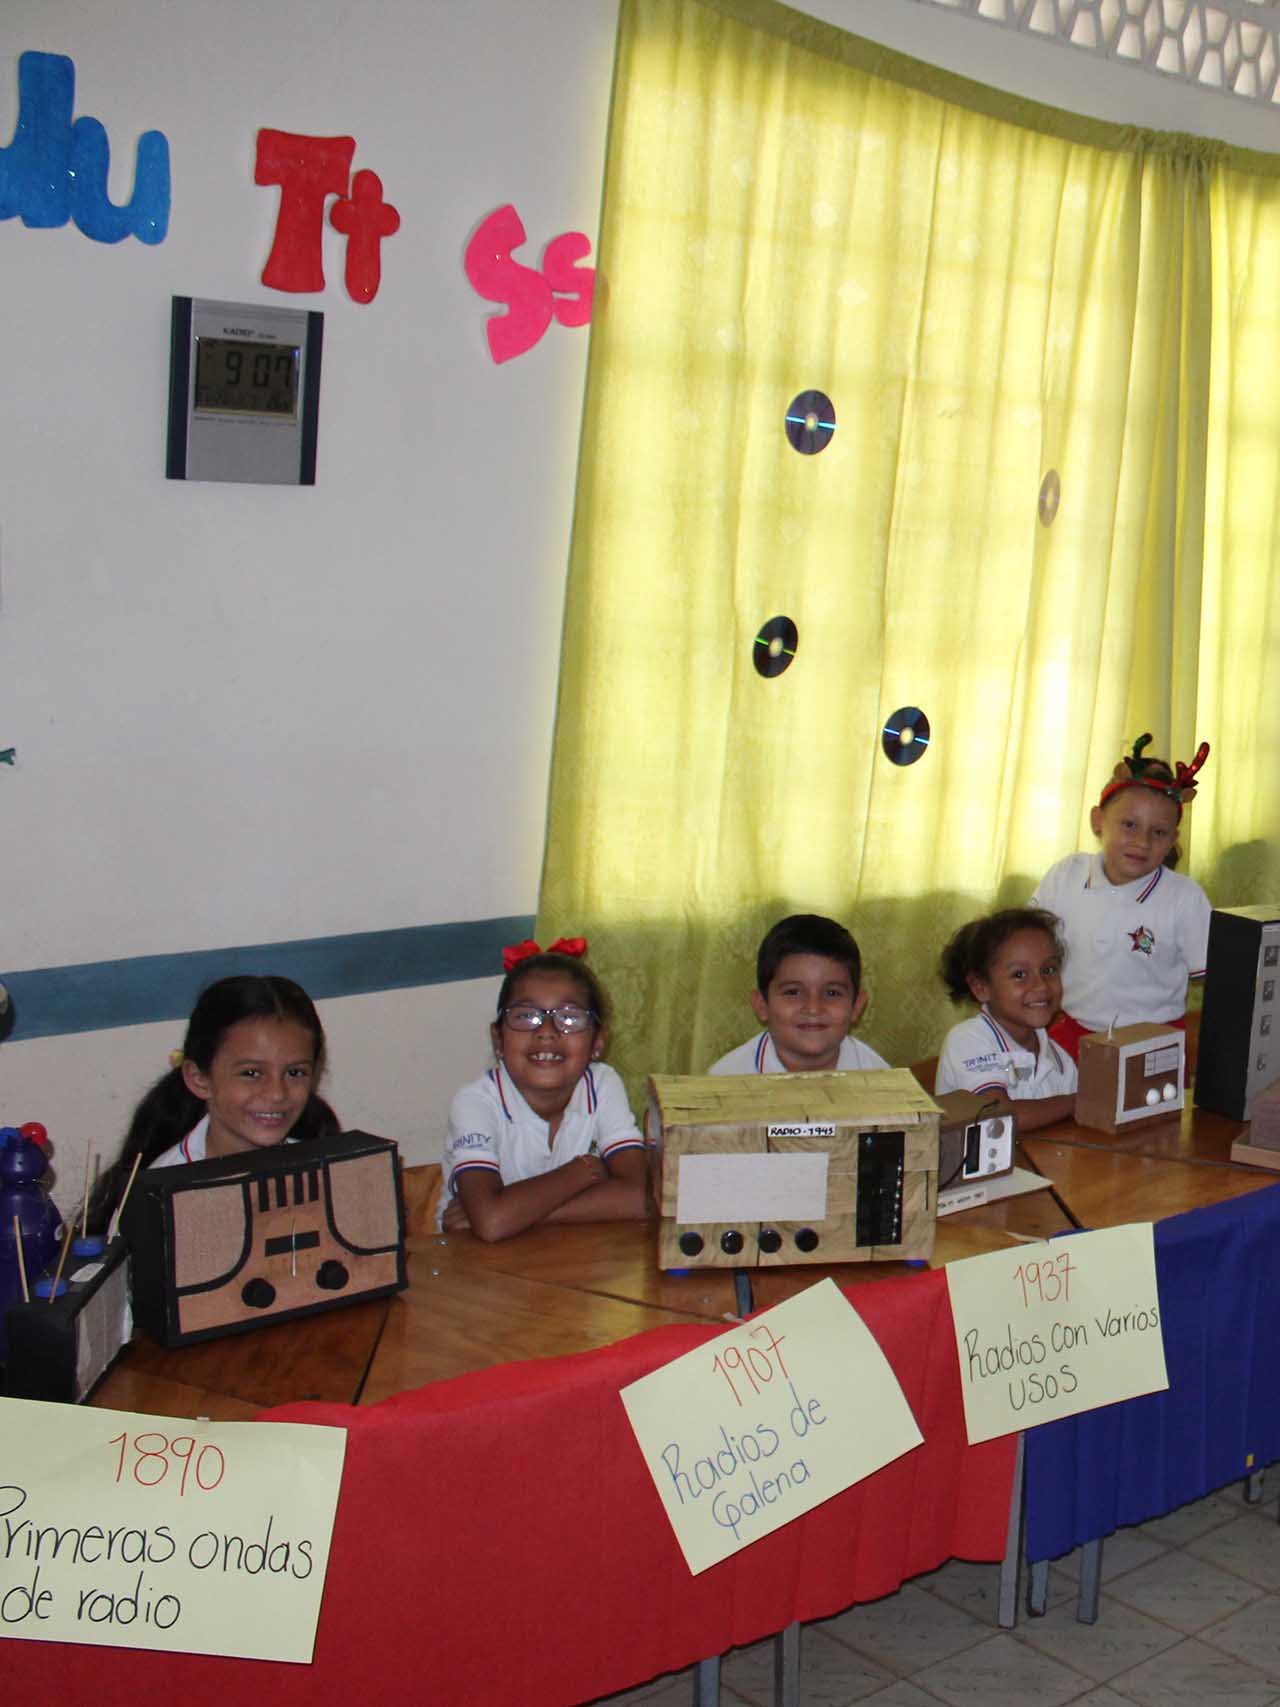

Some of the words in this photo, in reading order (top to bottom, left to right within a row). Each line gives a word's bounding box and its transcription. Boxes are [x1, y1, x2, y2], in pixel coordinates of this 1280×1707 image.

[255, 128, 400, 303] Tt
[464, 203, 600, 365] Ss
[962, 1053, 998, 1068] TRINIT
[1013, 1252, 1078, 1309] 1937
[712, 1325, 786, 1408] 1907
[963, 1322, 1047, 1383] Radios
[109, 1432, 225, 1497] 1890
[660, 1425, 780, 1506] Radios
[790, 1381, 827, 1438] de
[711, 1458, 812, 1541] Galena
[188, 1514, 313, 1579] ondas
[1, 1565, 53, 1623] de
[77, 1570, 181, 1629] radio
